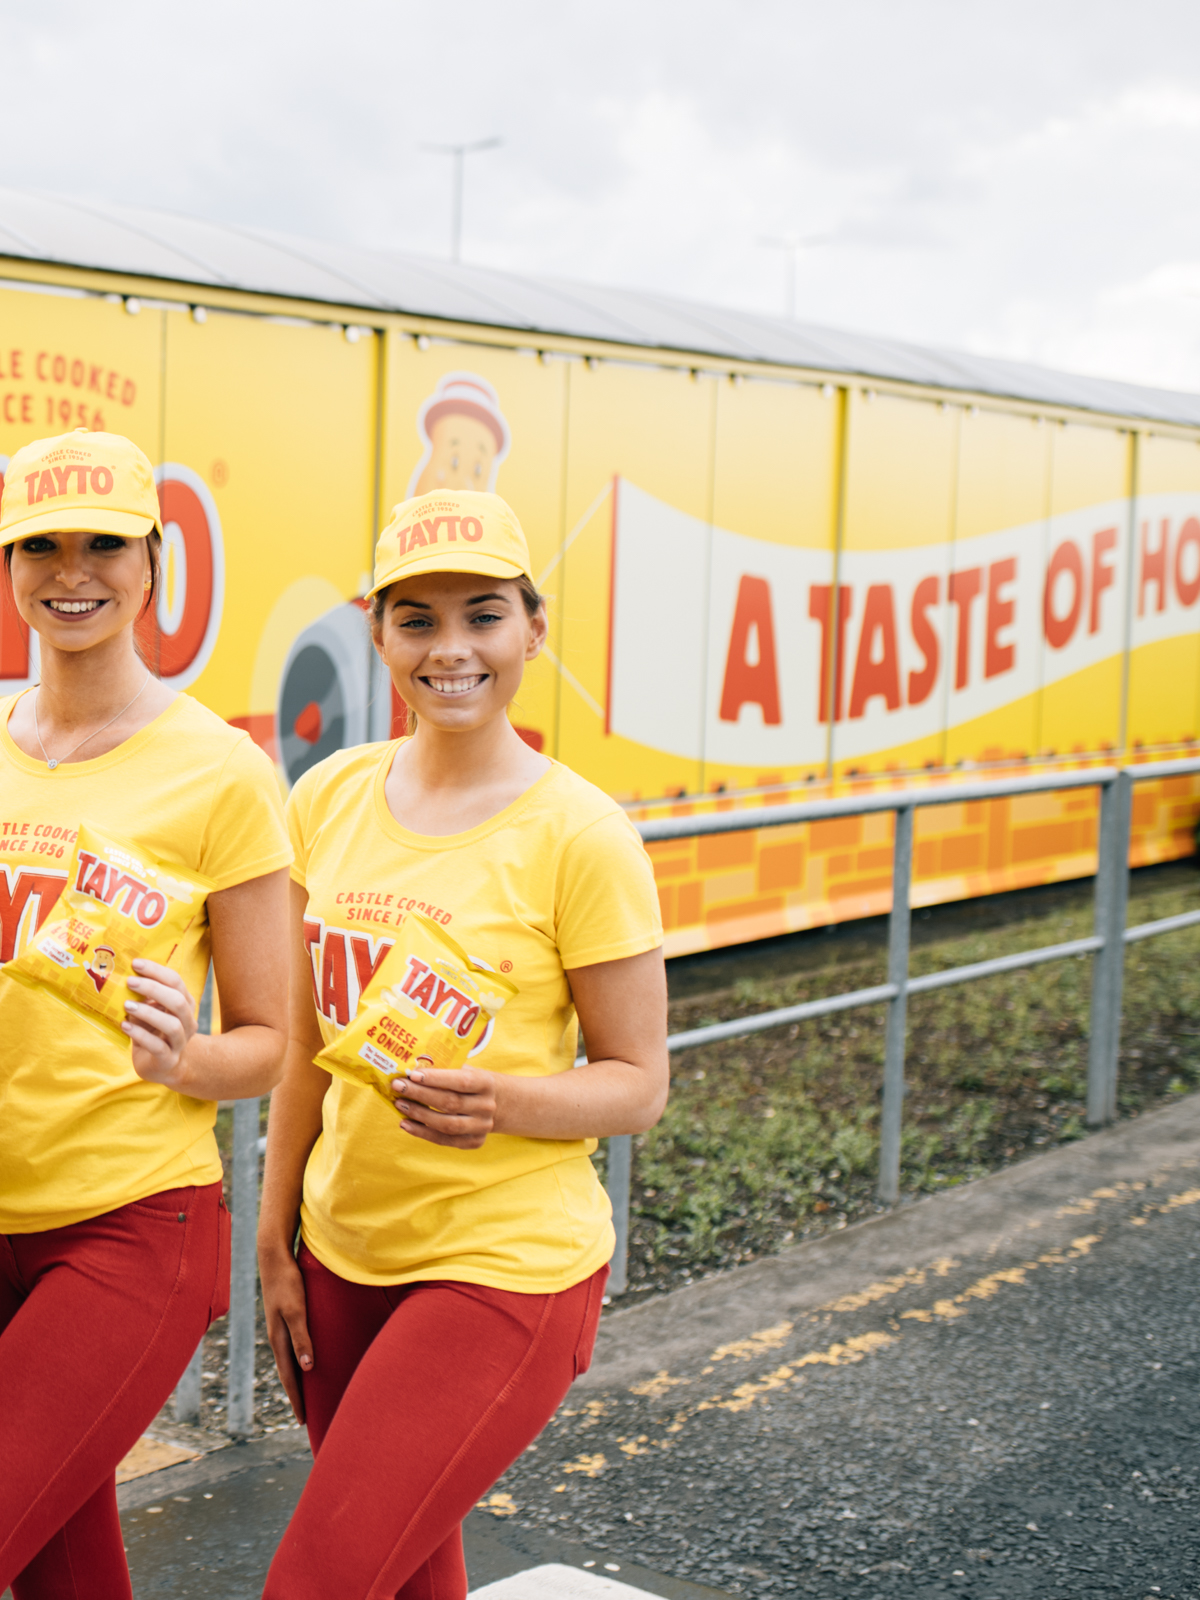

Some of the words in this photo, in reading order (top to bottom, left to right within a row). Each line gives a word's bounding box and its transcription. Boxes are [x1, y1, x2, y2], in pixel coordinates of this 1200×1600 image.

[35, 351, 137, 408] COOKED
[47, 395, 106, 433] 1956
[41, 448, 64, 462] CASTLE
[66, 448, 92, 458] COOKED
[48, 454, 66, 464] SINCE
[25, 464, 114, 506] TAYTO
[411, 502, 433, 518] CASTLE
[417, 507, 436, 518] SINCE
[396, 515, 484, 557] TAYTO
[718, 572, 783, 728] A
[806, 555, 1020, 725] TASTE
[1041, 523, 1120, 653] OF
[31, 841, 65, 859] 1956
[33, 824, 79, 844] COOKE
[75, 850, 166, 927] TAYTO
[335, 891, 394, 907] CASTLE
[397, 897, 452, 926] COOKED
[346, 908, 392, 924] SINCE
[400, 957, 481, 1037] TAYTO
[366, 1025, 377, 1038] &
[376, 1032, 413, 1064] ONION
[379, 1015, 418, 1050] CHEESE
